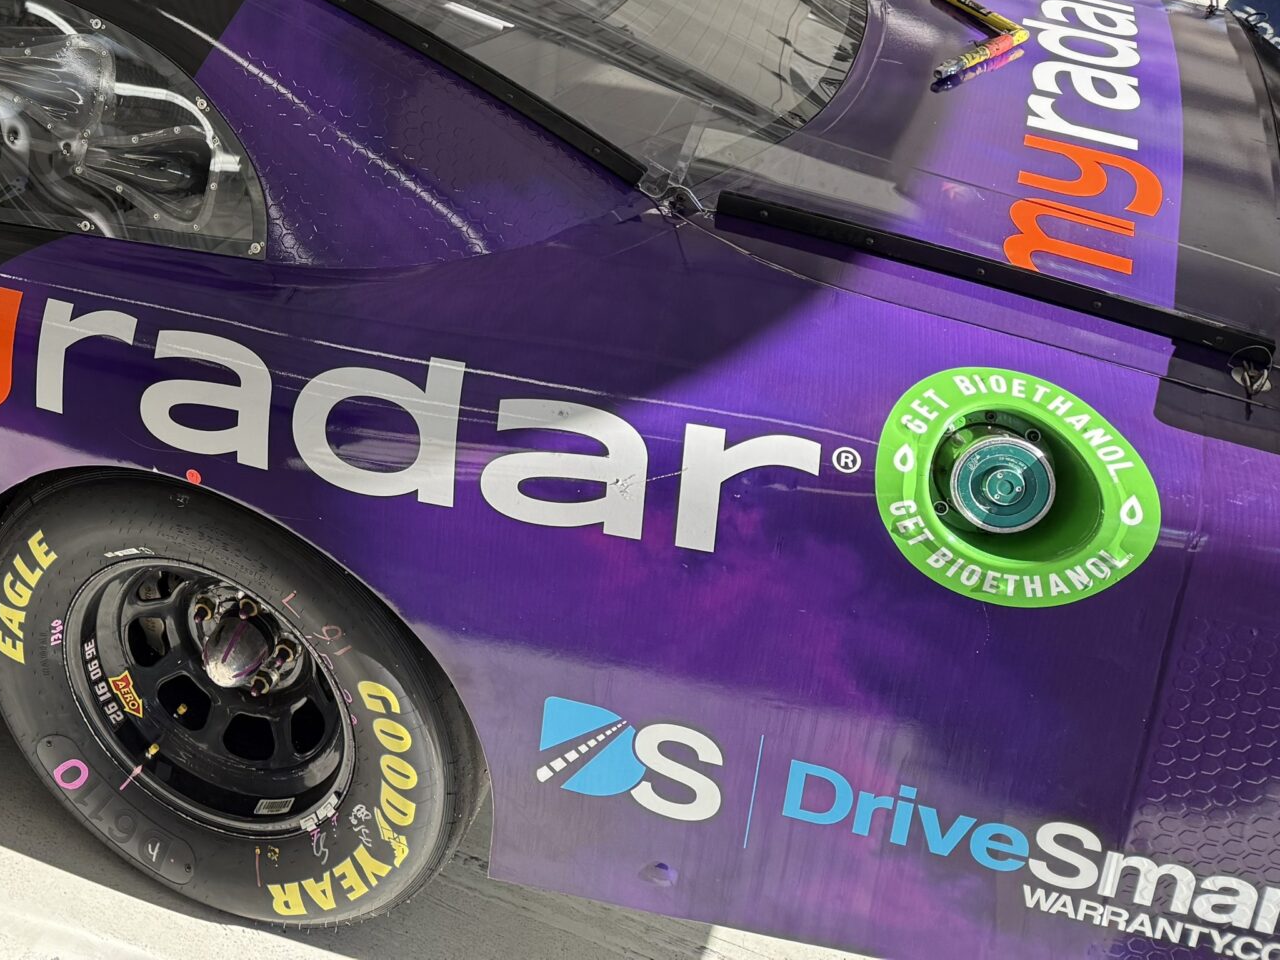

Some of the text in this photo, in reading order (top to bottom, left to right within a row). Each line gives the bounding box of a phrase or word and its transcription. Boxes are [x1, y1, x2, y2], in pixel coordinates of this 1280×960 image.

[900, 373, 1136, 484] GET BIOETHANOL
[889, 498, 936, 547] GET
[87, 659, 103, 682] 90
[94, 680, 113, 703] 91
[116, 680, 140, 712] AERO
[104, 701, 124, 726] 92
[265, 678, 420, 916] GOODYEAR
